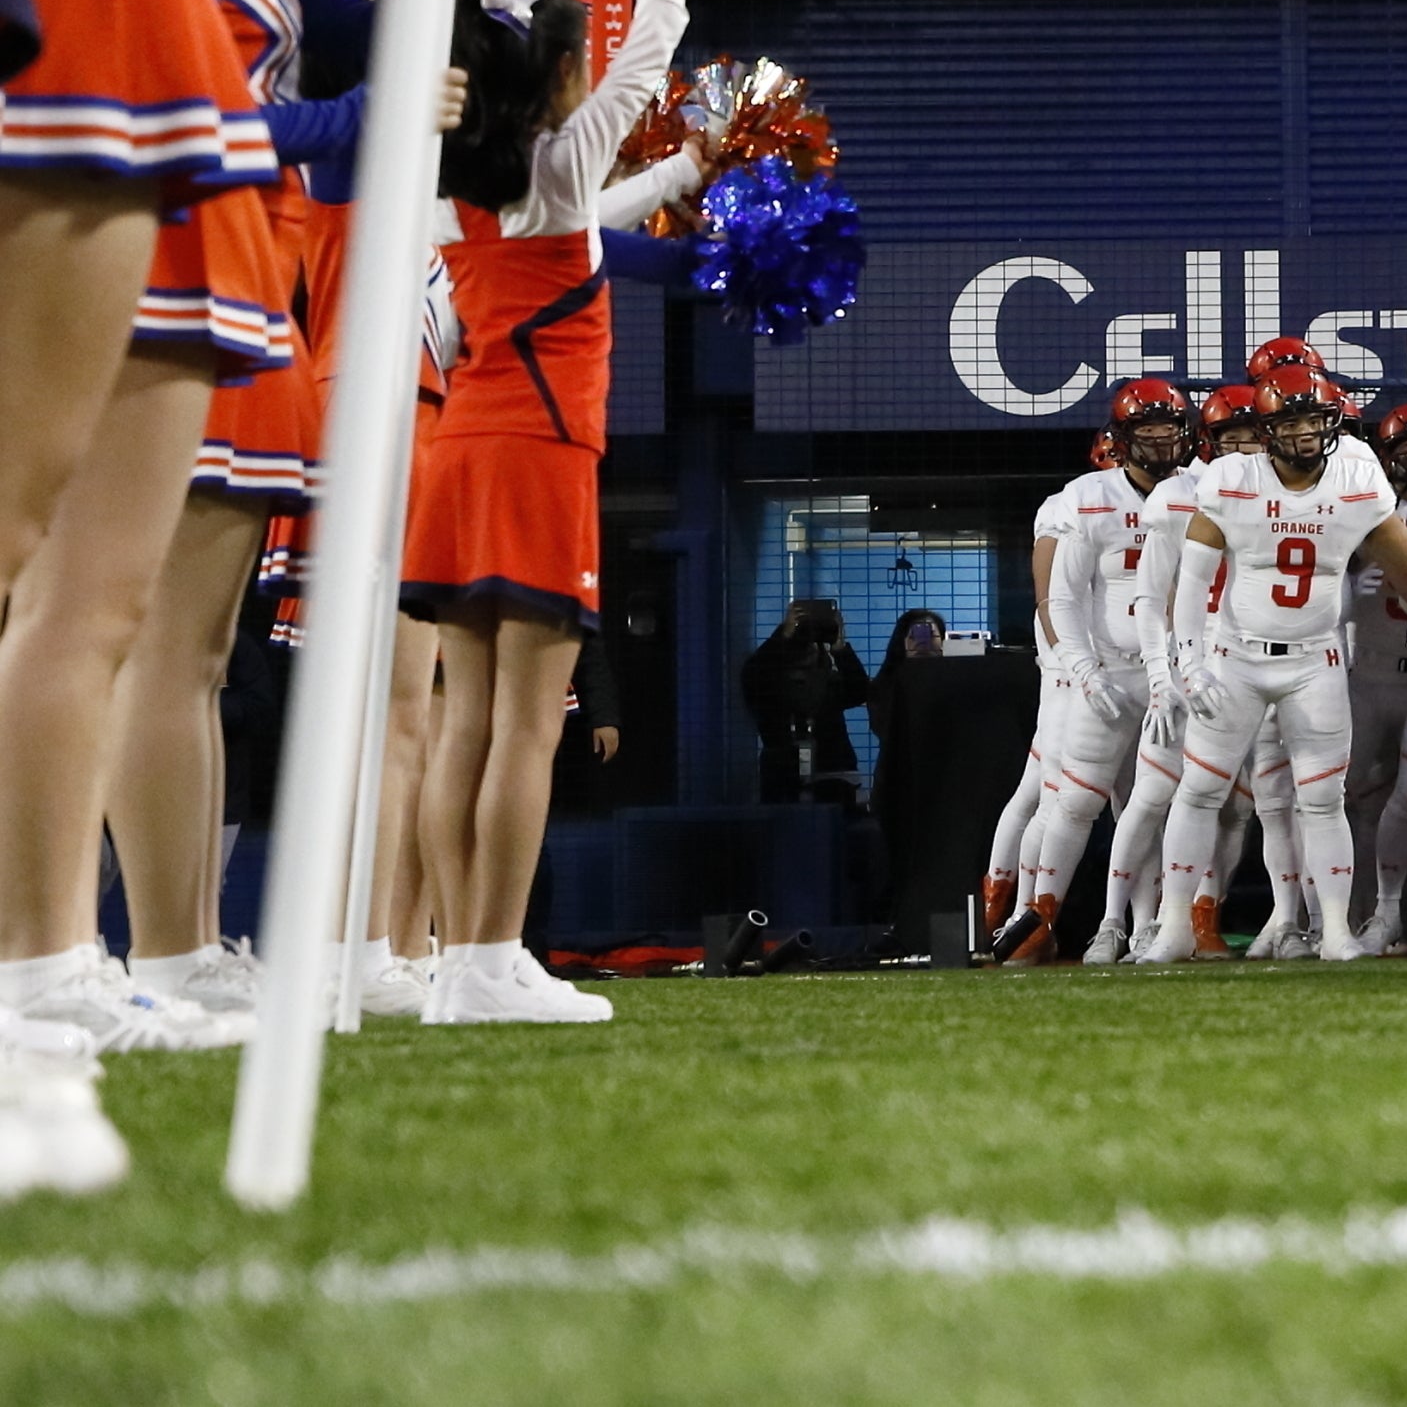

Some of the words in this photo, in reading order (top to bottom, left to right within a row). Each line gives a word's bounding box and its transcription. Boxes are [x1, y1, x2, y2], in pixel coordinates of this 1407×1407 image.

[1266, 500, 1281, 518] H
[1125, 512, 1139, 529] H
[1271, 522, 1325, 535] ORANGE
[1270, 537, 1317, 609] 9
